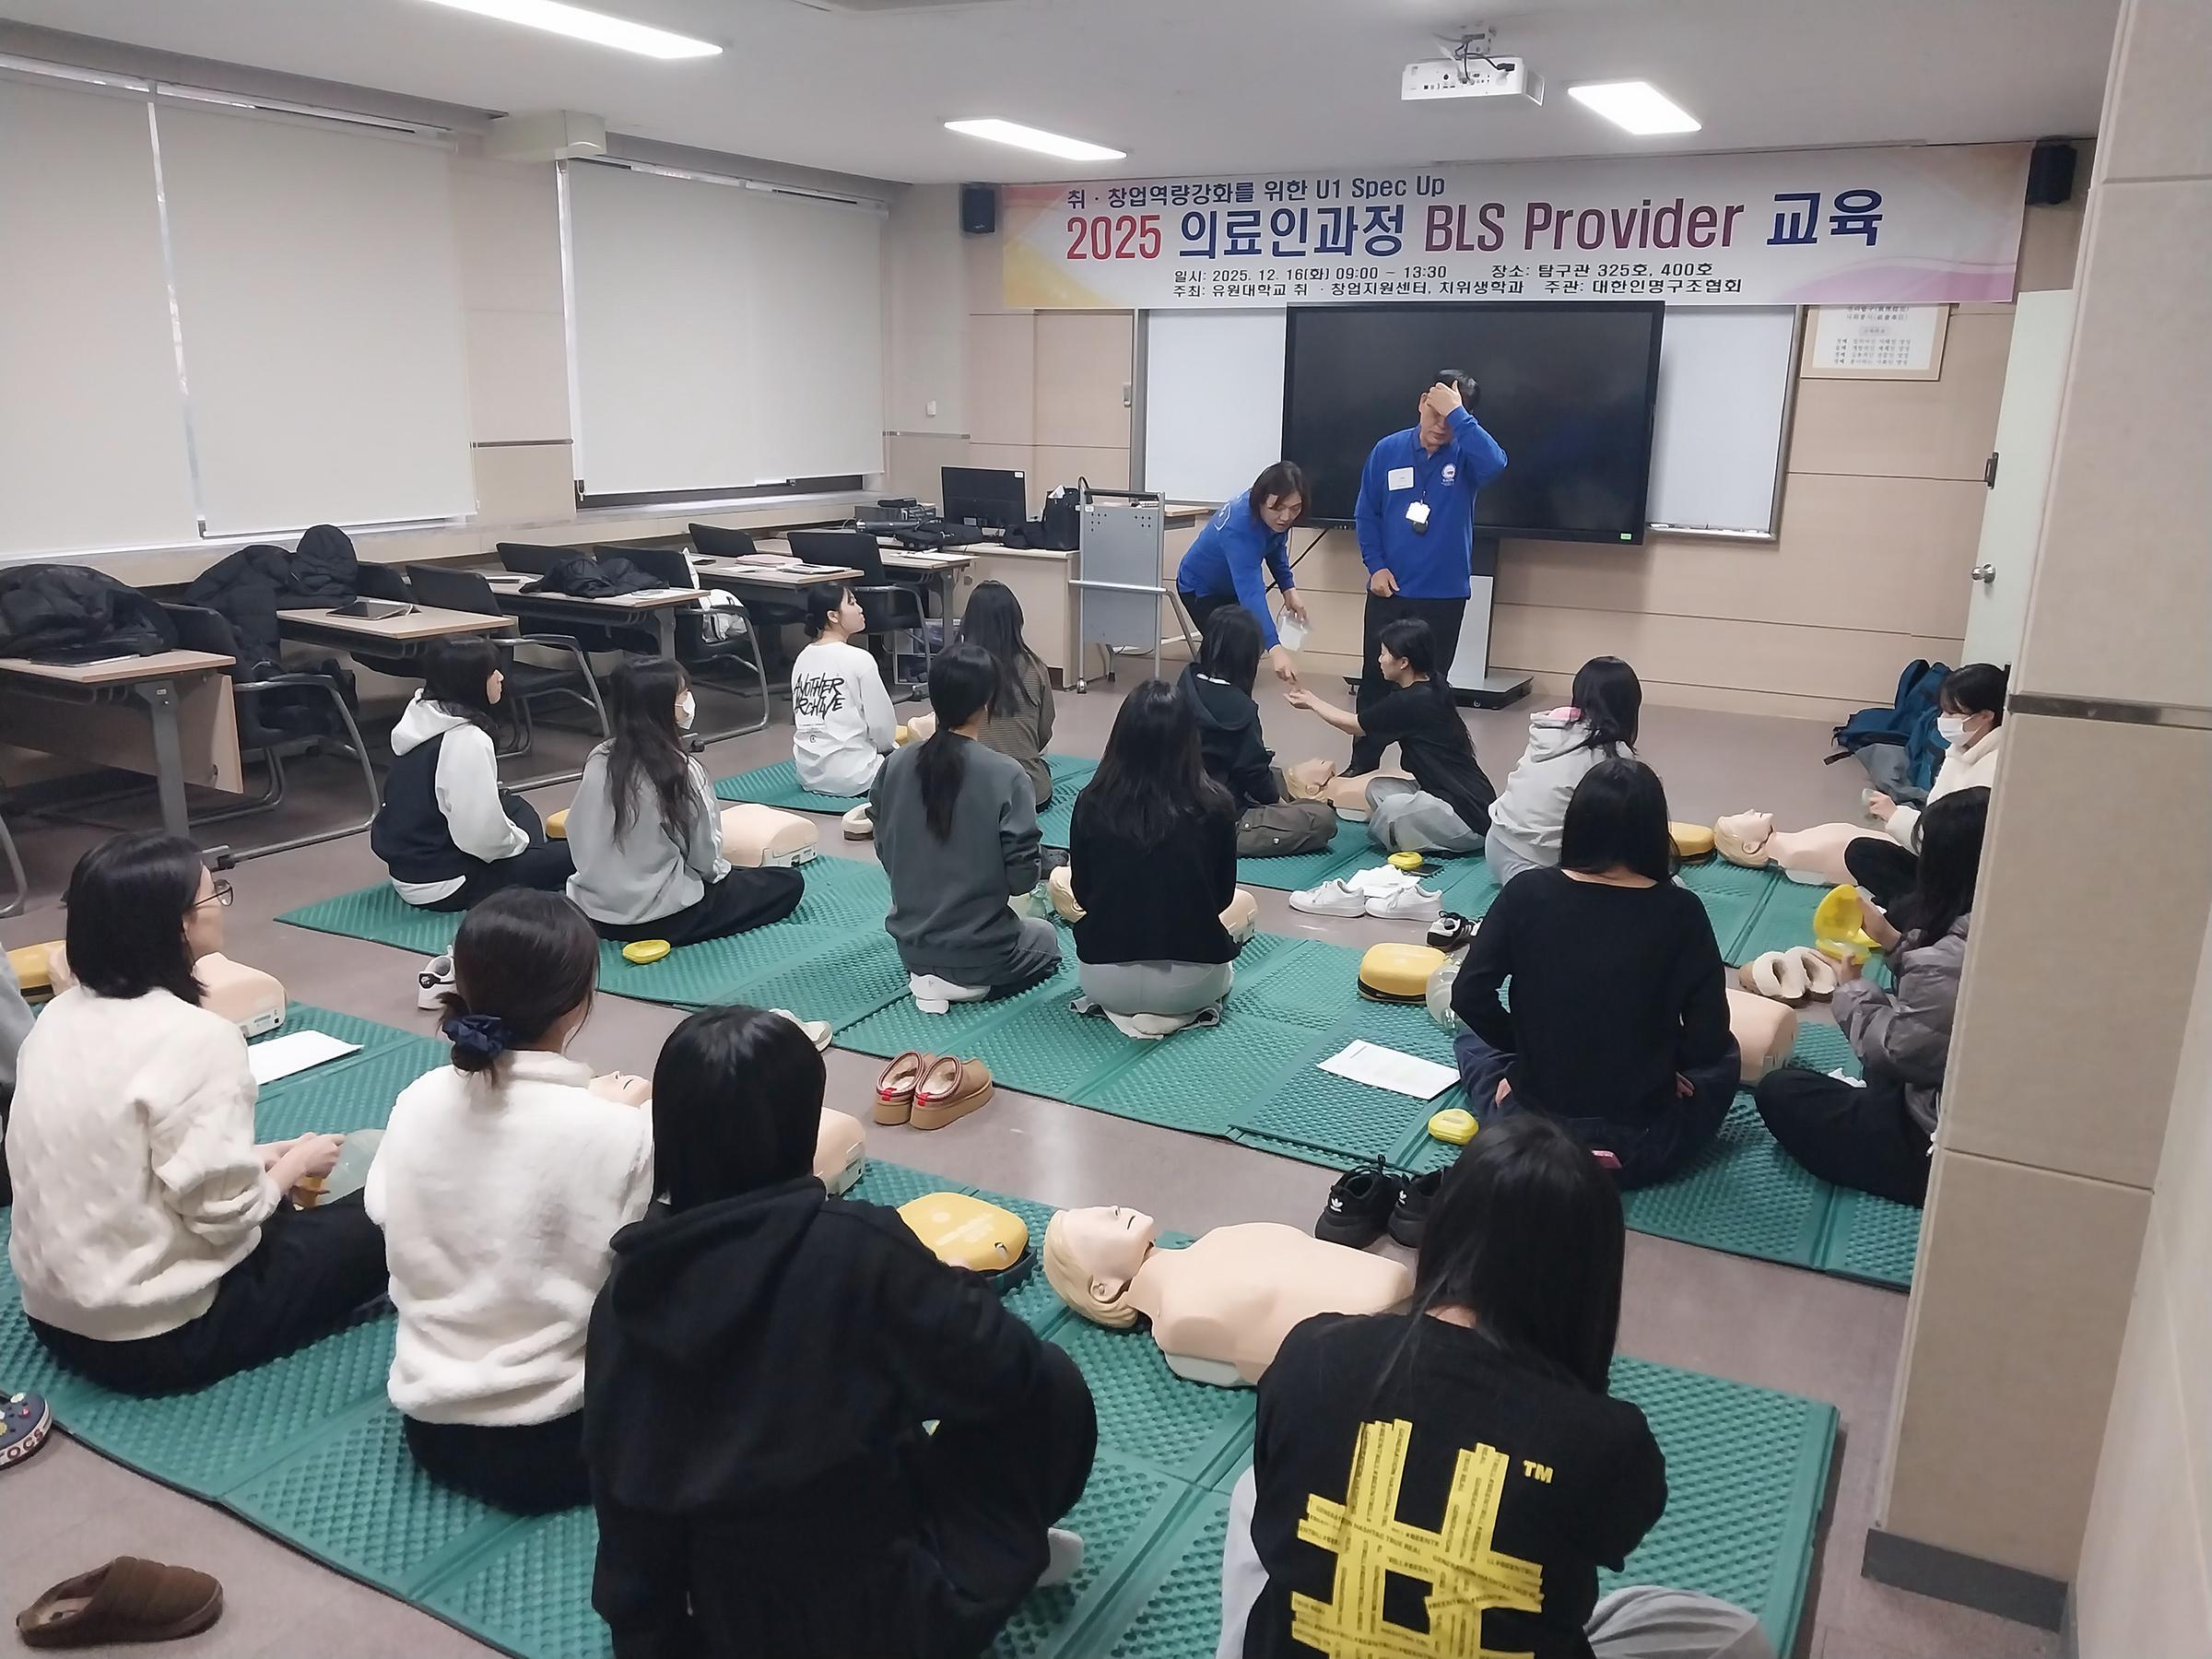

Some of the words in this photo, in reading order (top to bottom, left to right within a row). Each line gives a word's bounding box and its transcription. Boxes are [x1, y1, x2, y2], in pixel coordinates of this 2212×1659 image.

[1067, 189, 1085, 209] 취
[1108, 182, 1253, 209] 창업역량강화를
[1264, 179, 1307, 201] 위한
[1316, 179, 1340, 199] U1
[1351, 177, 1406, 199] Spec
[1417, 175, 1444, 197] Up
[1066, 214, 1161, 260] 2025
[1179, 204, 1404, 260] 의료인과정
[1424, 202, 1505, 253] BLS
[1524, 197, 1745, 251] Provider
[1766, 189, 1883, 246] 교육
[1174, 270, 1206, 283] 일시:
[1212, 269, 1252, 282] 2025.
[1259, 268, 1279, 281] 12.
[1287, 267, 1329, 280] 16(화)
[1335, 266, 1378, 280] 09:00
[1404, 265, 1447, 278] 13:30
[1491, 264, 1530, 278] 장소:
[1597, 263, 1653, 277] 325호,
[1660, 262, 1712, 276] 400호
[1173, 284, 1206, 298] 주최:
[1212, 283, 1287, 298] 유원대학교
[1293, 283, 1307, 296] 취
[1331, 280, 1431, 296] 창업지원센터,
[1439, 279, 1524, 295] 치위생학과
[1544, 279, 1584, 294] 주관:
[1593, 278, 1742, 294] 대한인명구조협회
[794, 672, 845, 697] ANOTHER
[1523, 1459, 1554, 1484] TM
